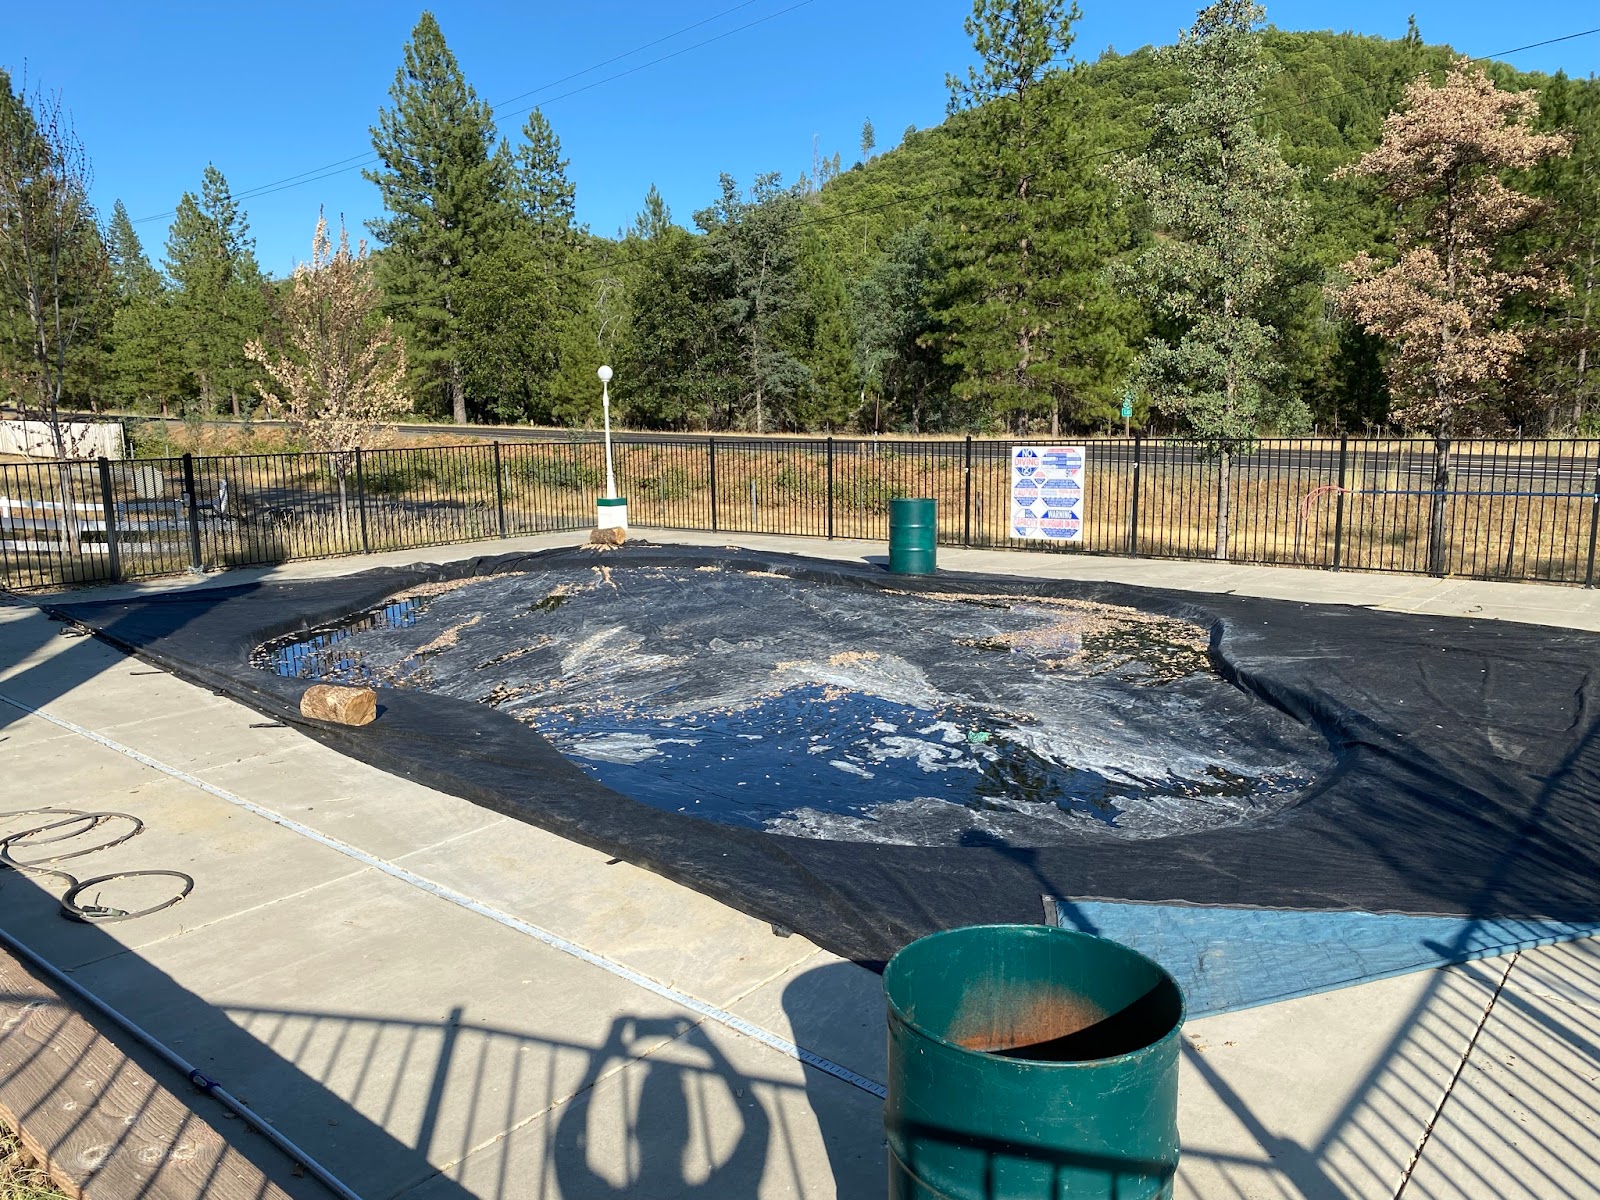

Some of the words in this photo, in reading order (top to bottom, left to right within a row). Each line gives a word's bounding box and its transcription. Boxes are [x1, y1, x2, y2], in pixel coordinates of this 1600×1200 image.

[1022, 449, 1032, 457] NO
[1014, 458, 1039, 466] DIVING
[1048, 510, 1072, 519] WARNING
[1013, 518, 1038, 526] CAPACITY
[1071, 520, 1080, 528] DUTY
